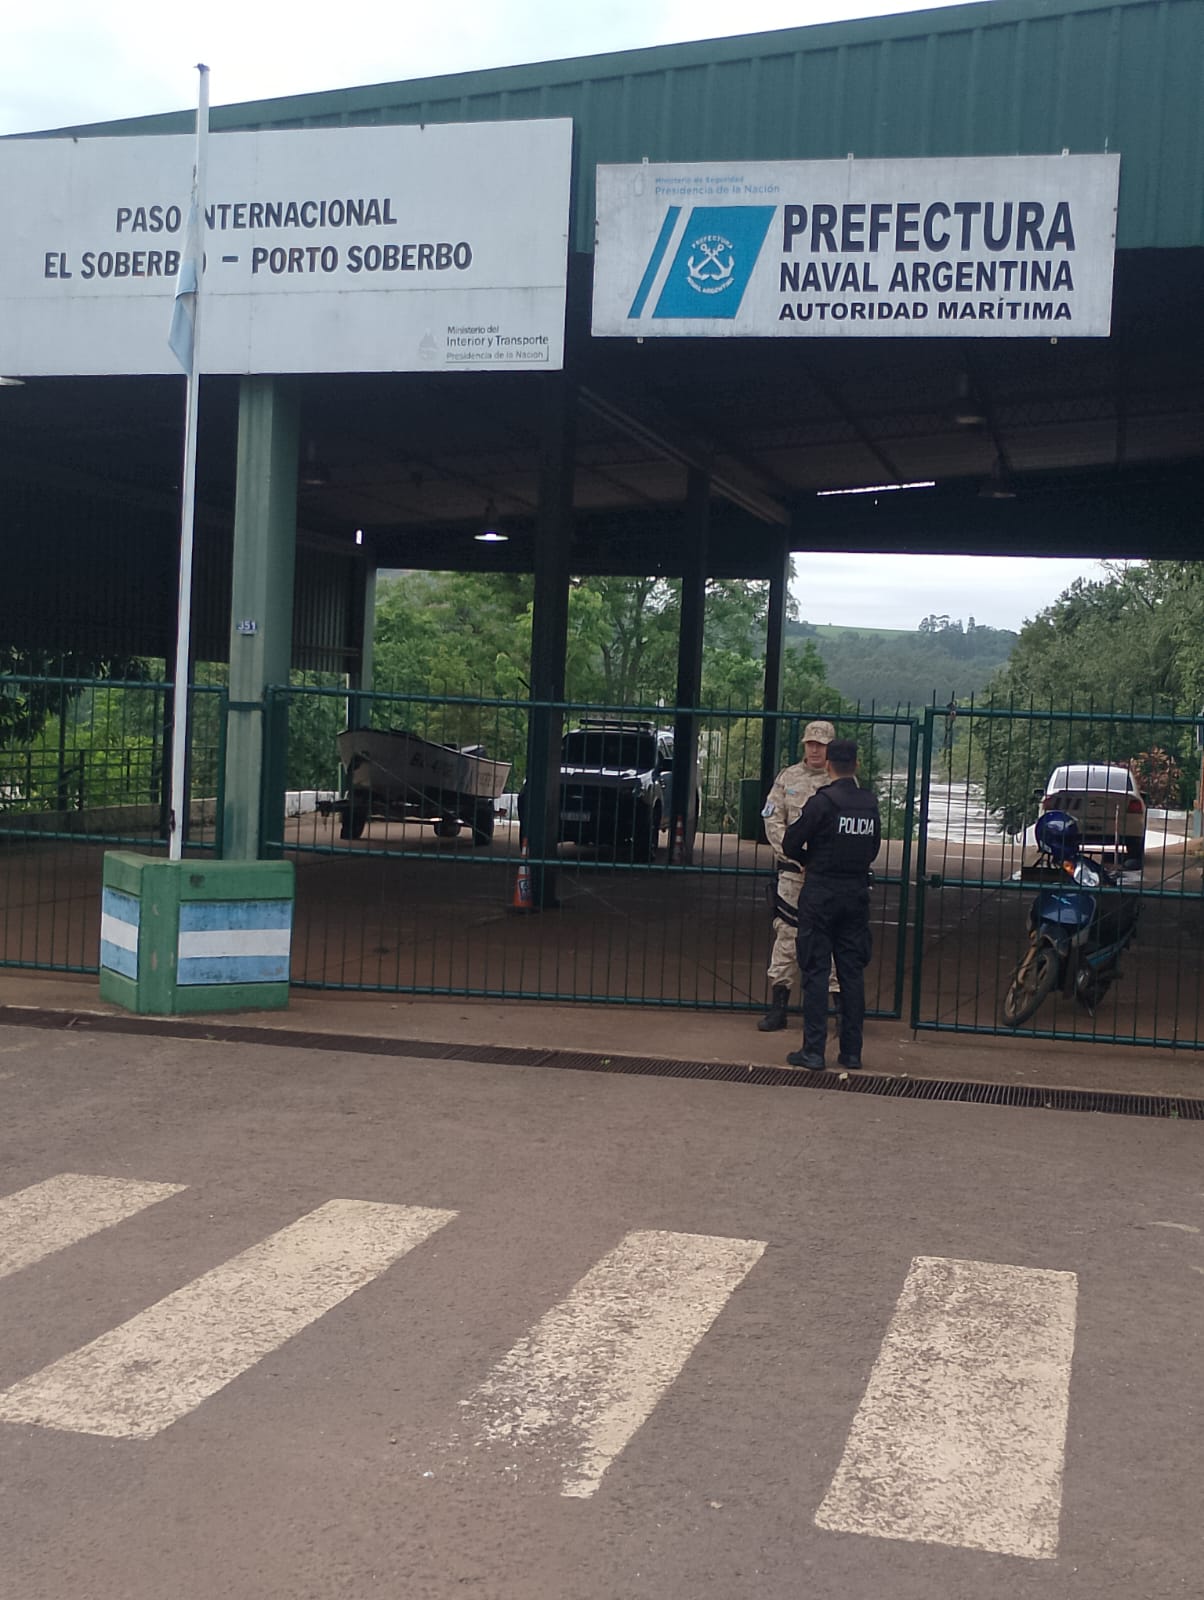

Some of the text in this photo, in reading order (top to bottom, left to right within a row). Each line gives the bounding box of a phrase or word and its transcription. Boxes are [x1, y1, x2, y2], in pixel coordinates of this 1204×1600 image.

[655, 184, 780, 195] Presidencia de la Nación
[116, 197, 397, 233] PASO NTERNACIONAL
[783, 202, 1075, 252] PREFECTURA
[44, 252, 73, 279] EL
[81, 250, 207, 279] SOBERB
[251, 245, 339, 275] PORTO
[346, 242, 473, 272] SOBERBO
[779, 260, 1074, 292] NAVAL ARGENTINA
[779, 297, 1072, 321] AUTORIDAD MARÍTIMA
[447, 325, 499, 335] Ministerio del
[447, 335, 549, 347] Interior y Transporte
[446, 352, 492, 360] Presidencia
